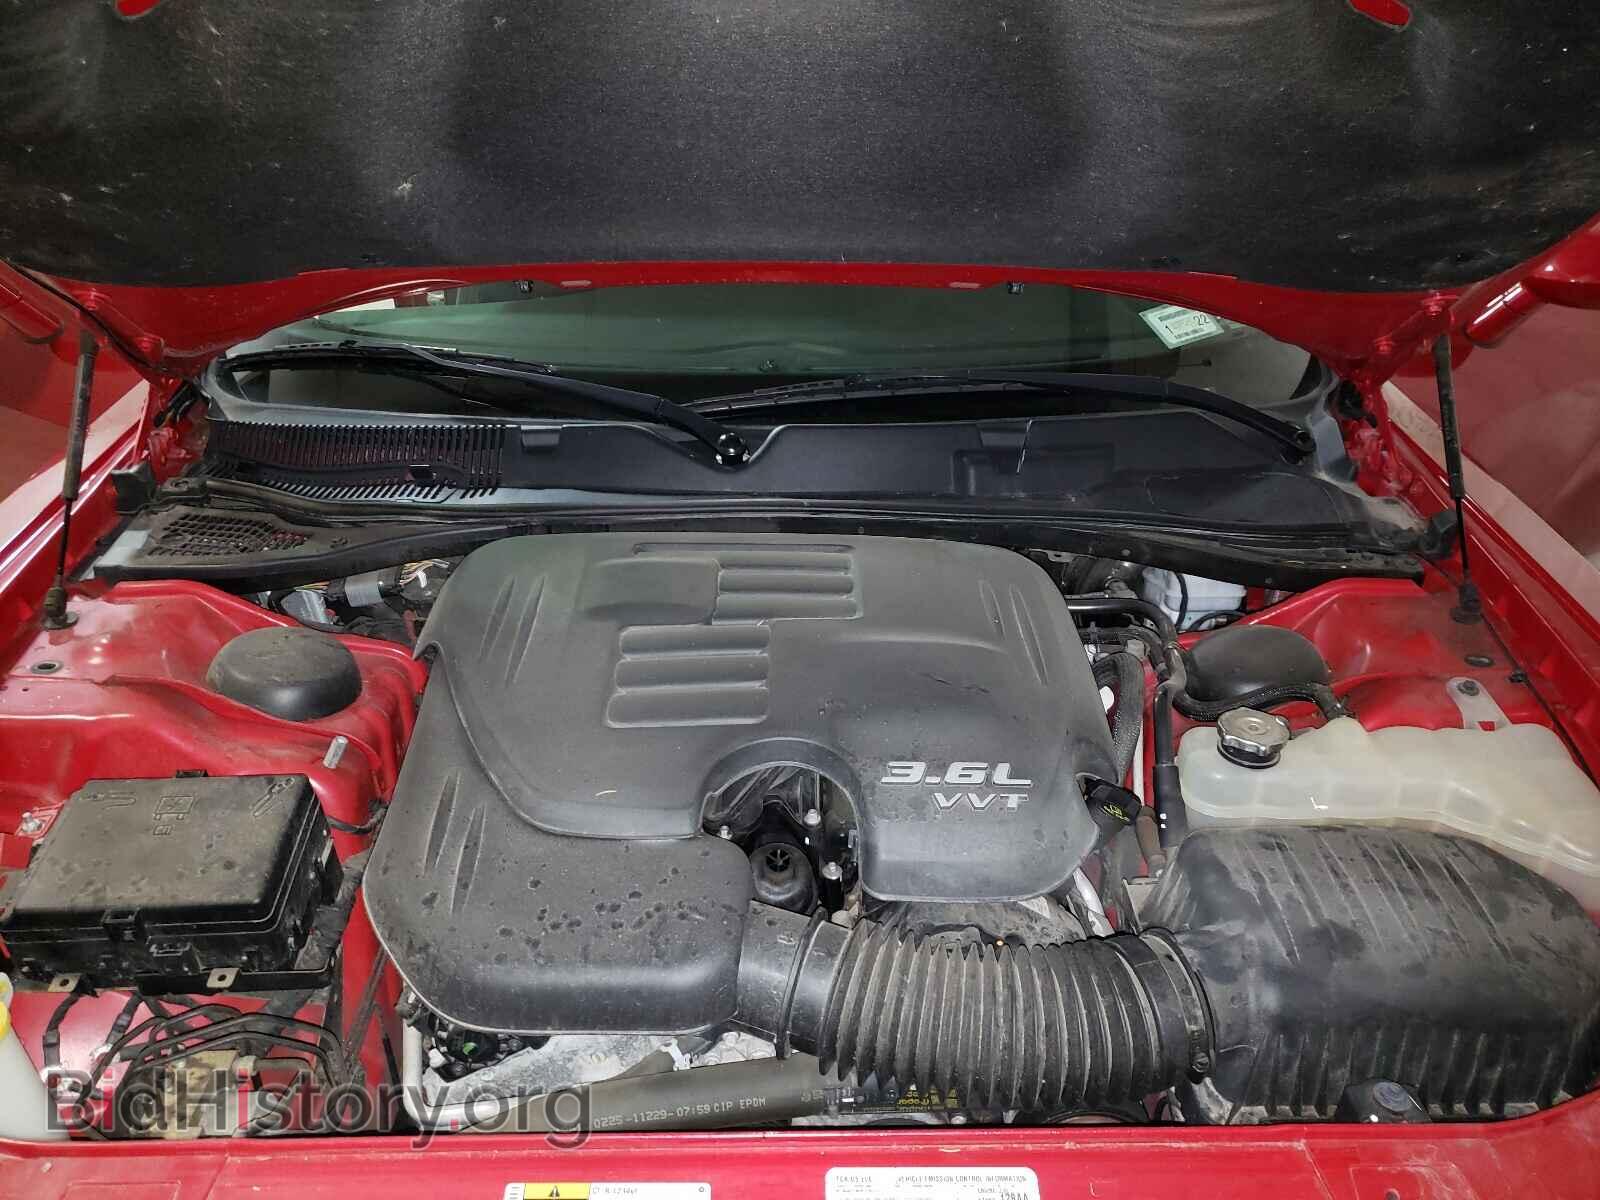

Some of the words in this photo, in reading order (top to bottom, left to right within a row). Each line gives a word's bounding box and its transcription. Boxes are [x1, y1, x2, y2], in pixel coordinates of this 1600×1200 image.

[1192, 314, 1209, 326] 22
[880, 761, 1033, 788] 3.6L
[931, 792, 1029, 811] VVT
